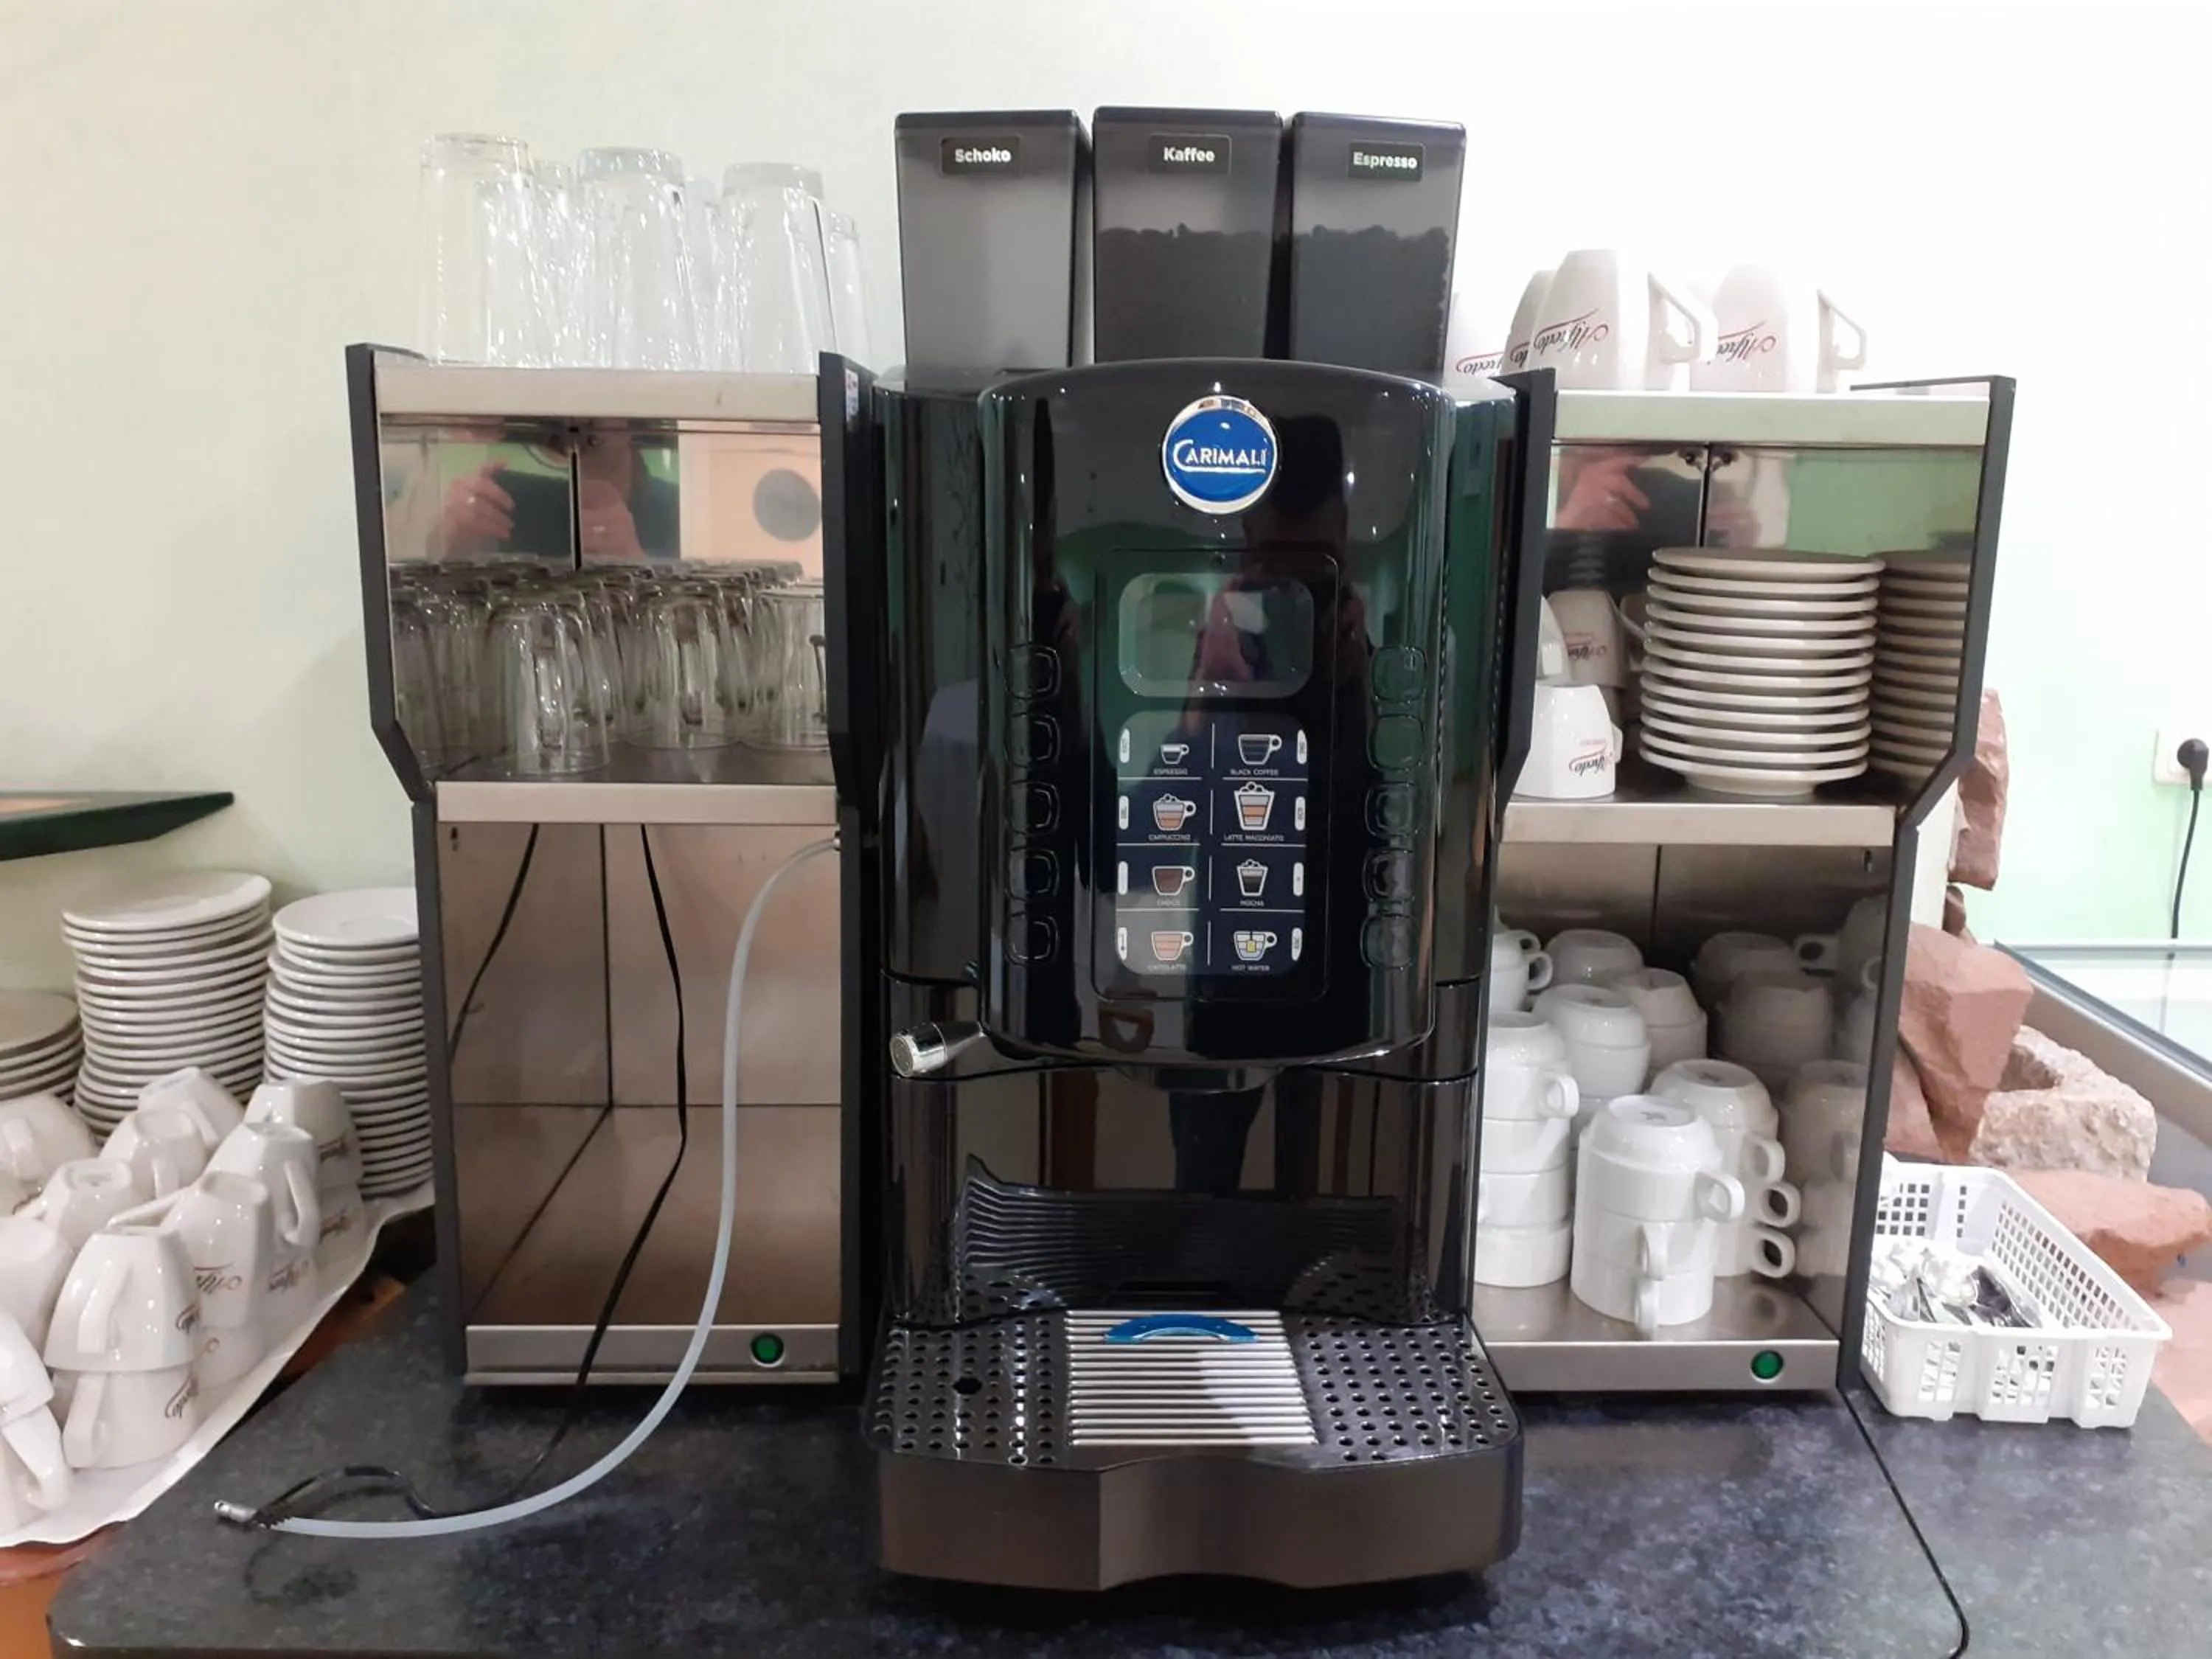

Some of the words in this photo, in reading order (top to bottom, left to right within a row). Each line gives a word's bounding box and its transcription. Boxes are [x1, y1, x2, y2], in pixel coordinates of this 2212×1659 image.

[955, 147, 1011, 163] Schoko
[1164, 146, 1215, 162] Kaffee
[1353, 151, 1418, 169] Espresso
[1173, 439, 1266, 473] CARIMALI
[1230, 768, 1251, 776] BLACK
[1253, 768, 1279, 776] COFFEE
[1223, 833, 1244, 842] LATTE
[1232, 964, 1246, 973] HOT
[1248, 964, 1270, 973] WATER
